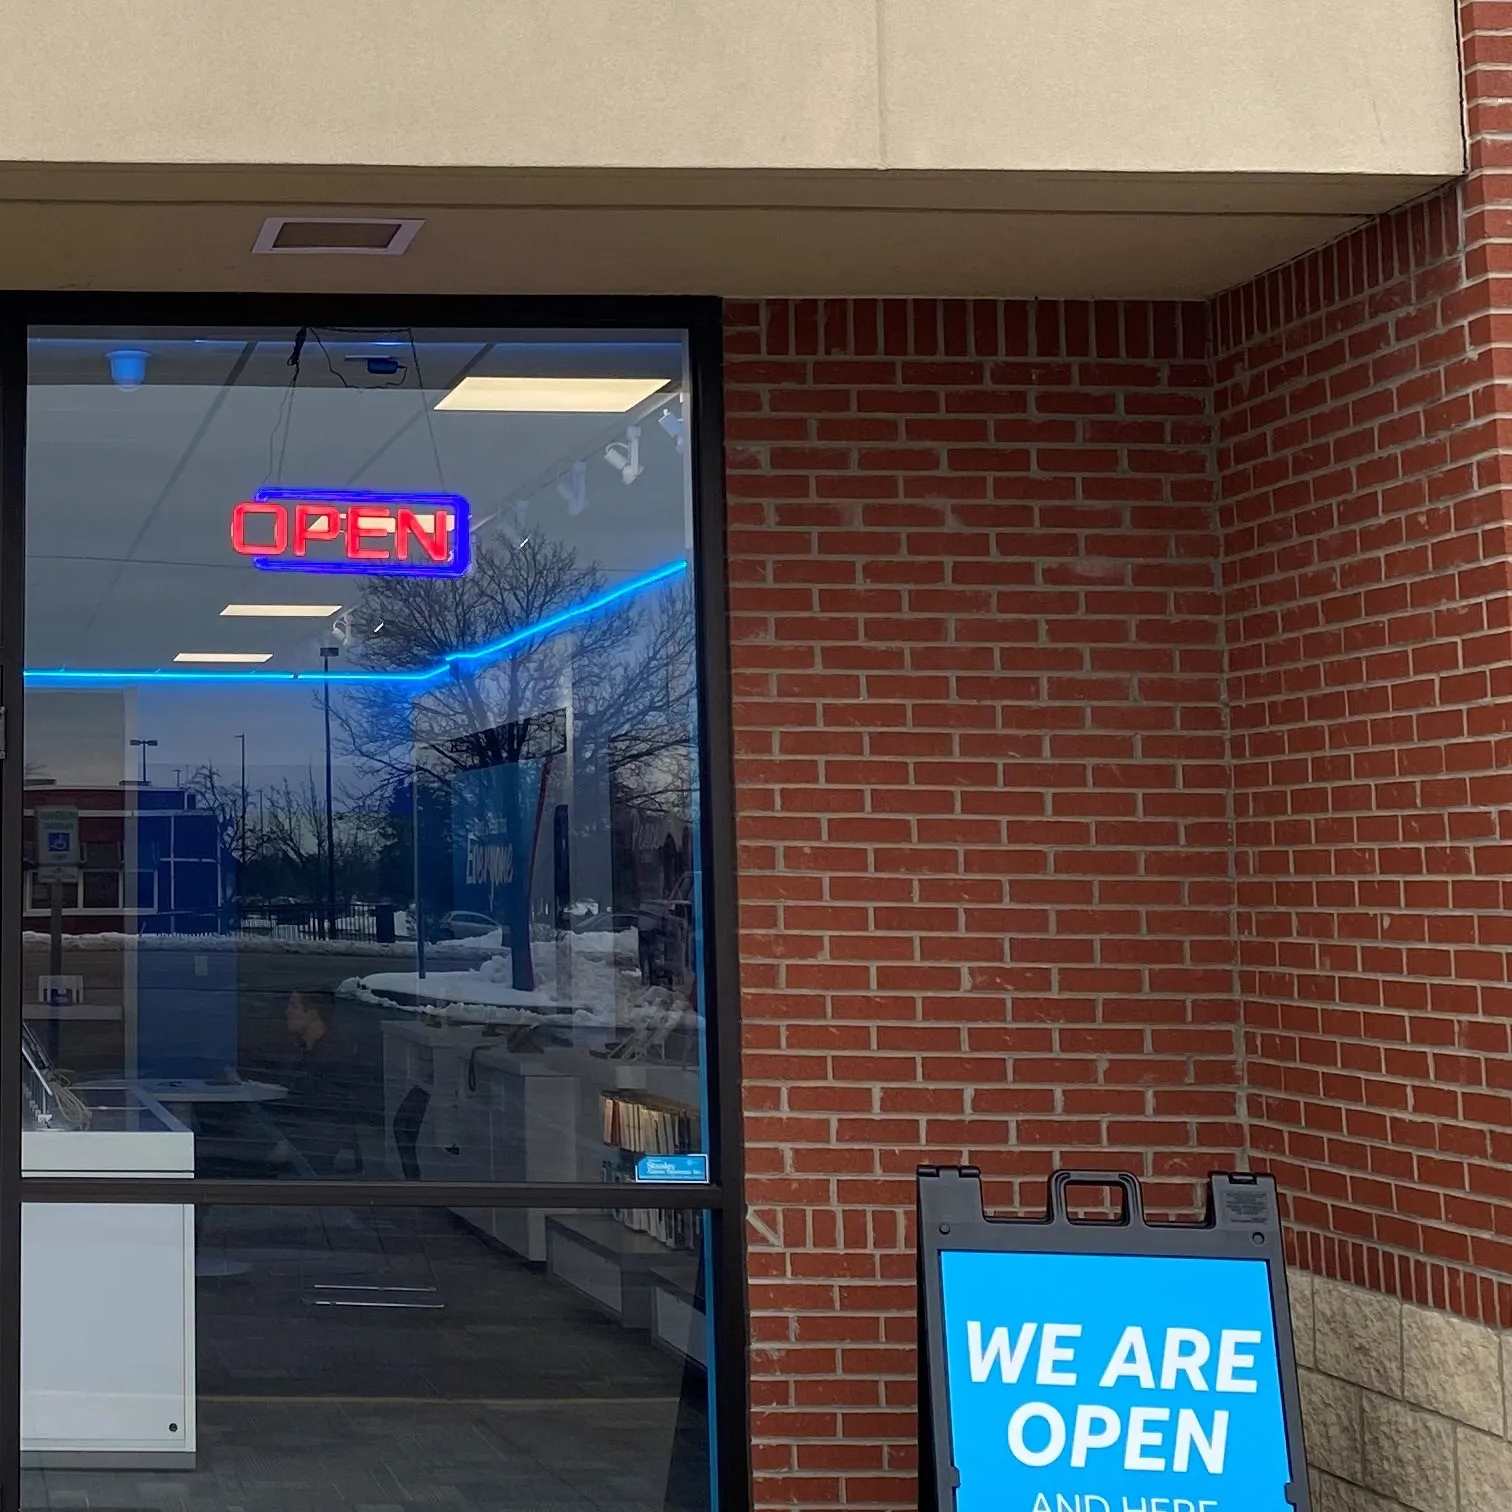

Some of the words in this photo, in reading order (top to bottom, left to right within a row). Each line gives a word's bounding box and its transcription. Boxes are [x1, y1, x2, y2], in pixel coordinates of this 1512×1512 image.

[231, 502, 448, 561] OPEN
[966, 1320, 1082, 1386] WE
[1099, 1325, 1262, 1393] ARE
[1007, 1401, 1230, 1474] OPEN
[1031, 1492, 1111, 1512] AND
